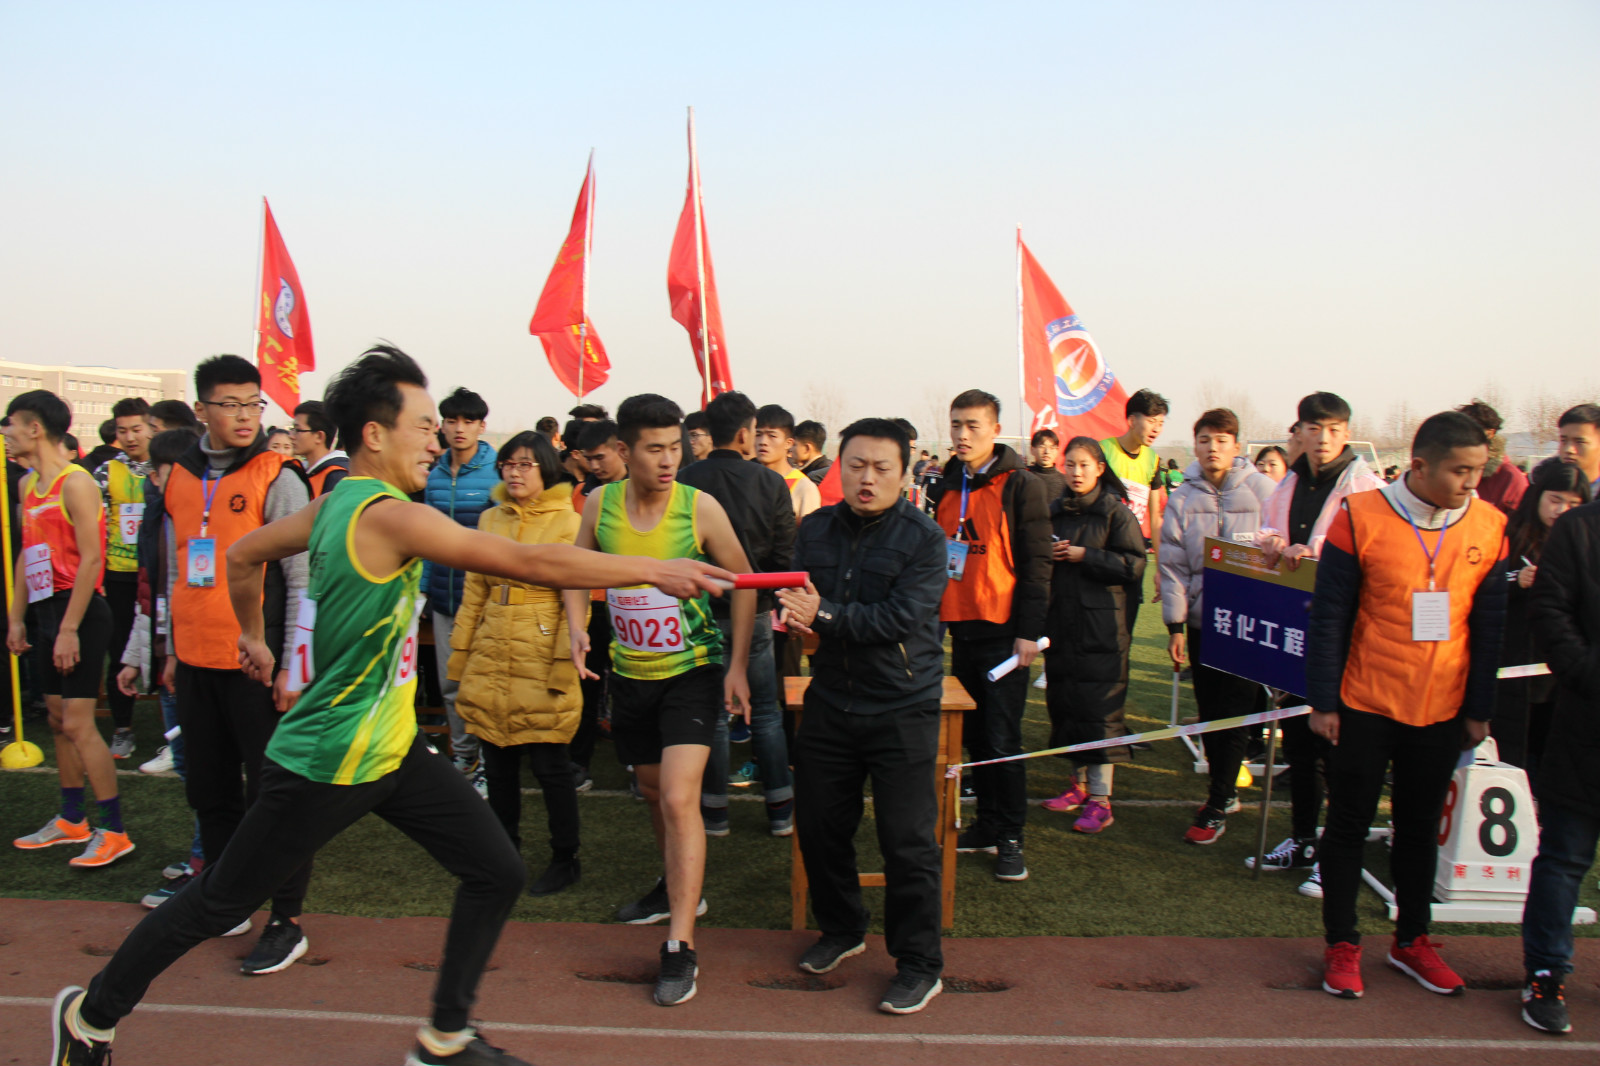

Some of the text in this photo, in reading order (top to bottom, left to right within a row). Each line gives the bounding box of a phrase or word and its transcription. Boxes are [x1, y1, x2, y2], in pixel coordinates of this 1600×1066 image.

[614, 615, 682, 648] 9023
[1213, 606, 1305, 658] 轻化工程
[1478, 786, 1518, 857] 8
